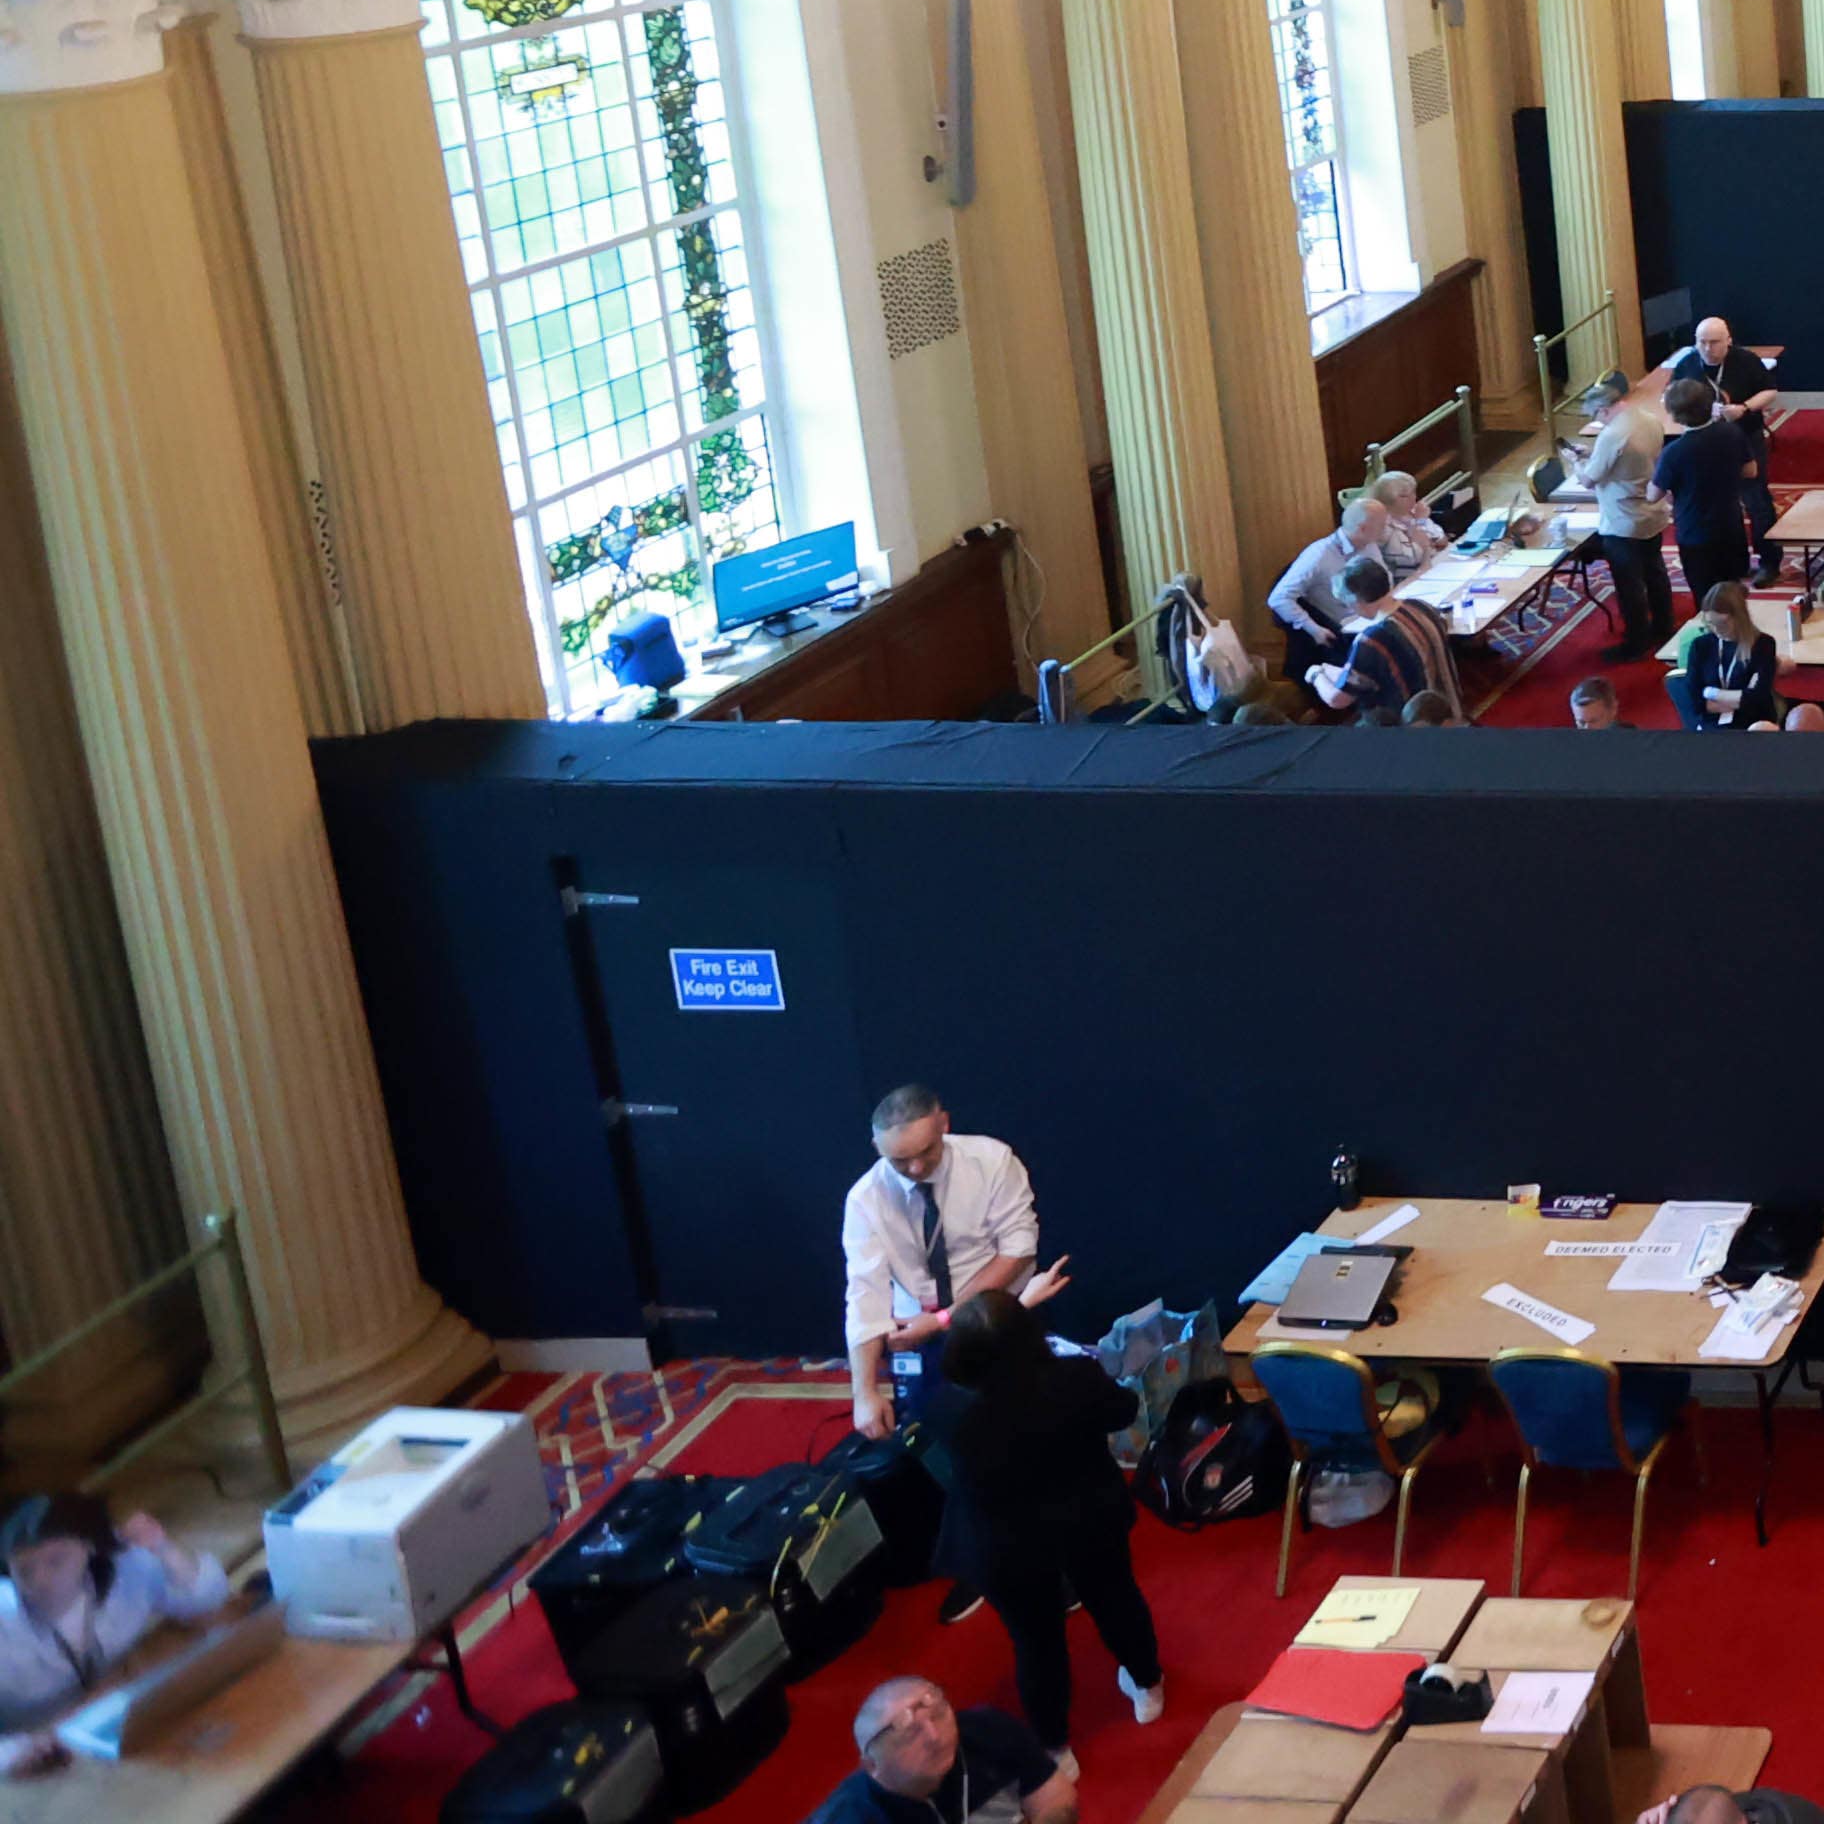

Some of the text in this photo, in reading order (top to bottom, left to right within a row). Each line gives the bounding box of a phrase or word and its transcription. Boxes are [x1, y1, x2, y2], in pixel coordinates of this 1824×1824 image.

[690, 959, 759, 976] Fire Exit
[683, 979, 773, 1000] Keep Clear
[1553, 1197, 1608, 1210] fngers
[1555, 1245, 1672, 1254] DEEMED ELECTED
[1506, 1297, 1568, 1327] EXCLUDED
